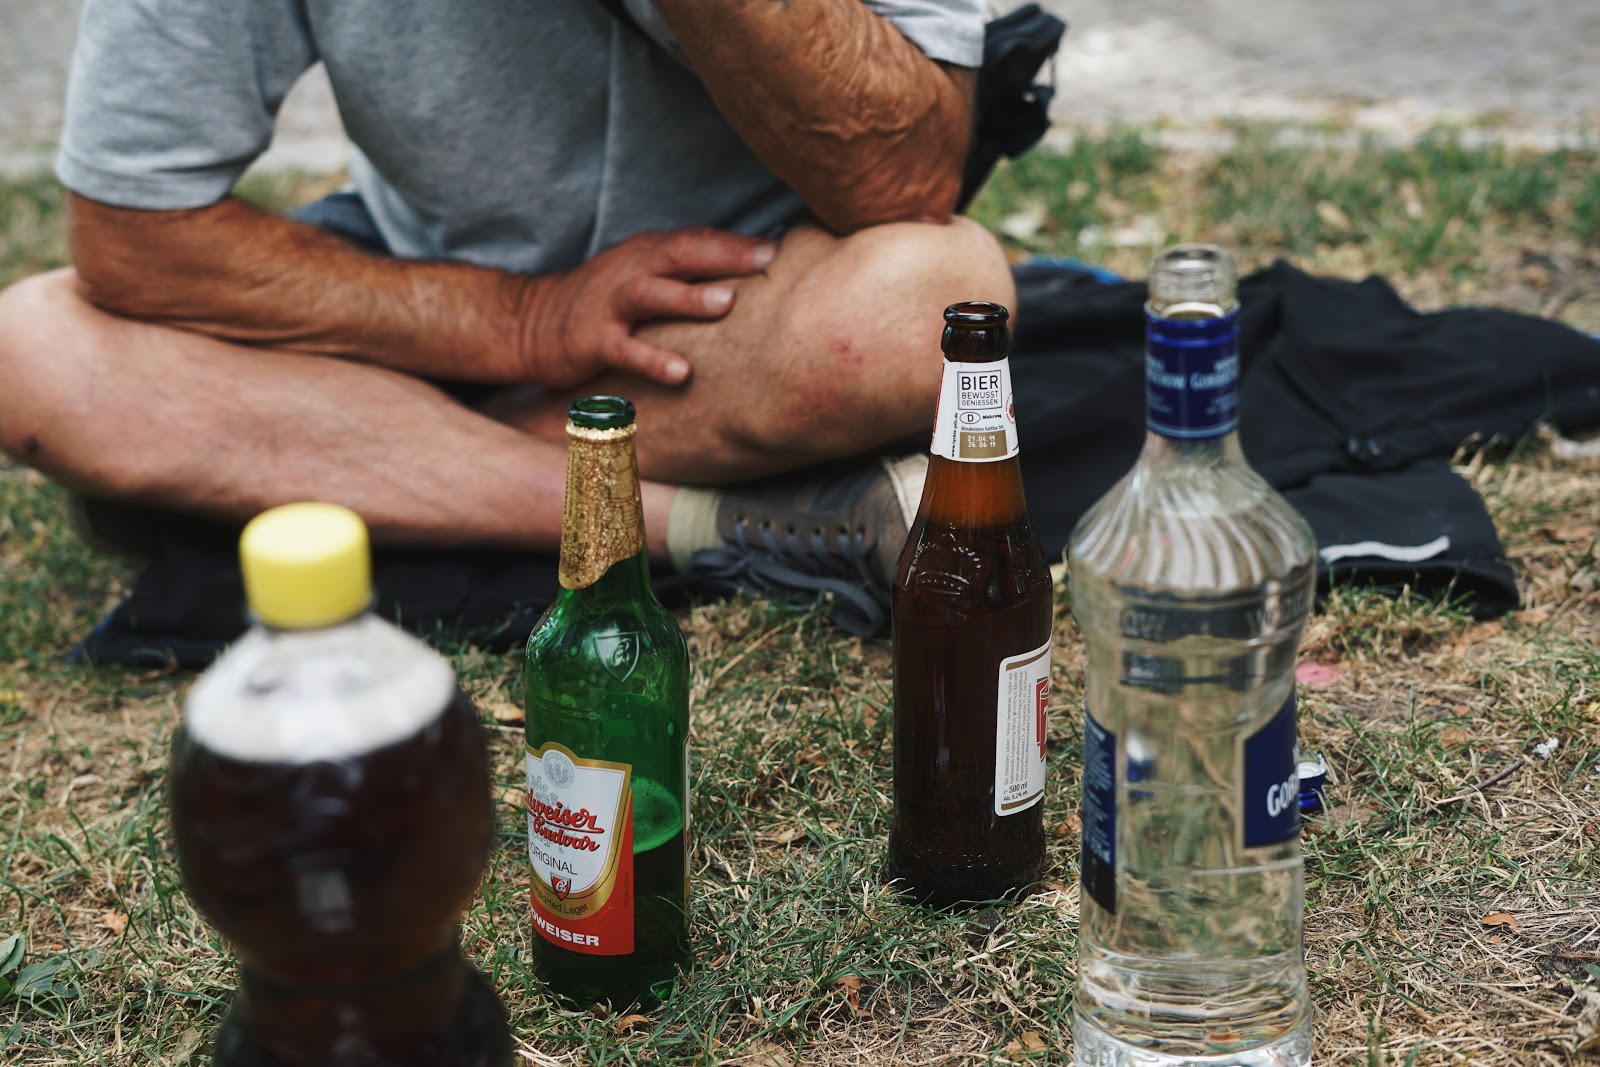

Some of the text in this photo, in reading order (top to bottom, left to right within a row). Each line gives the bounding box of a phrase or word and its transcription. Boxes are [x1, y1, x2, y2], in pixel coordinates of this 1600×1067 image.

[961, 374, 999, 391] BIER
[961, 390, 998, 400] BEWUSST
[961, 399, 998, 407] GENIESSEN
[967, 414, 974, 422] D
[1009, 781, 1027, 794] 500 ml
[533, 815, 601, 852] Budvar
[529, 842, 578, 876] ORIGINAL
[563, 902, 589, 916] Lager
